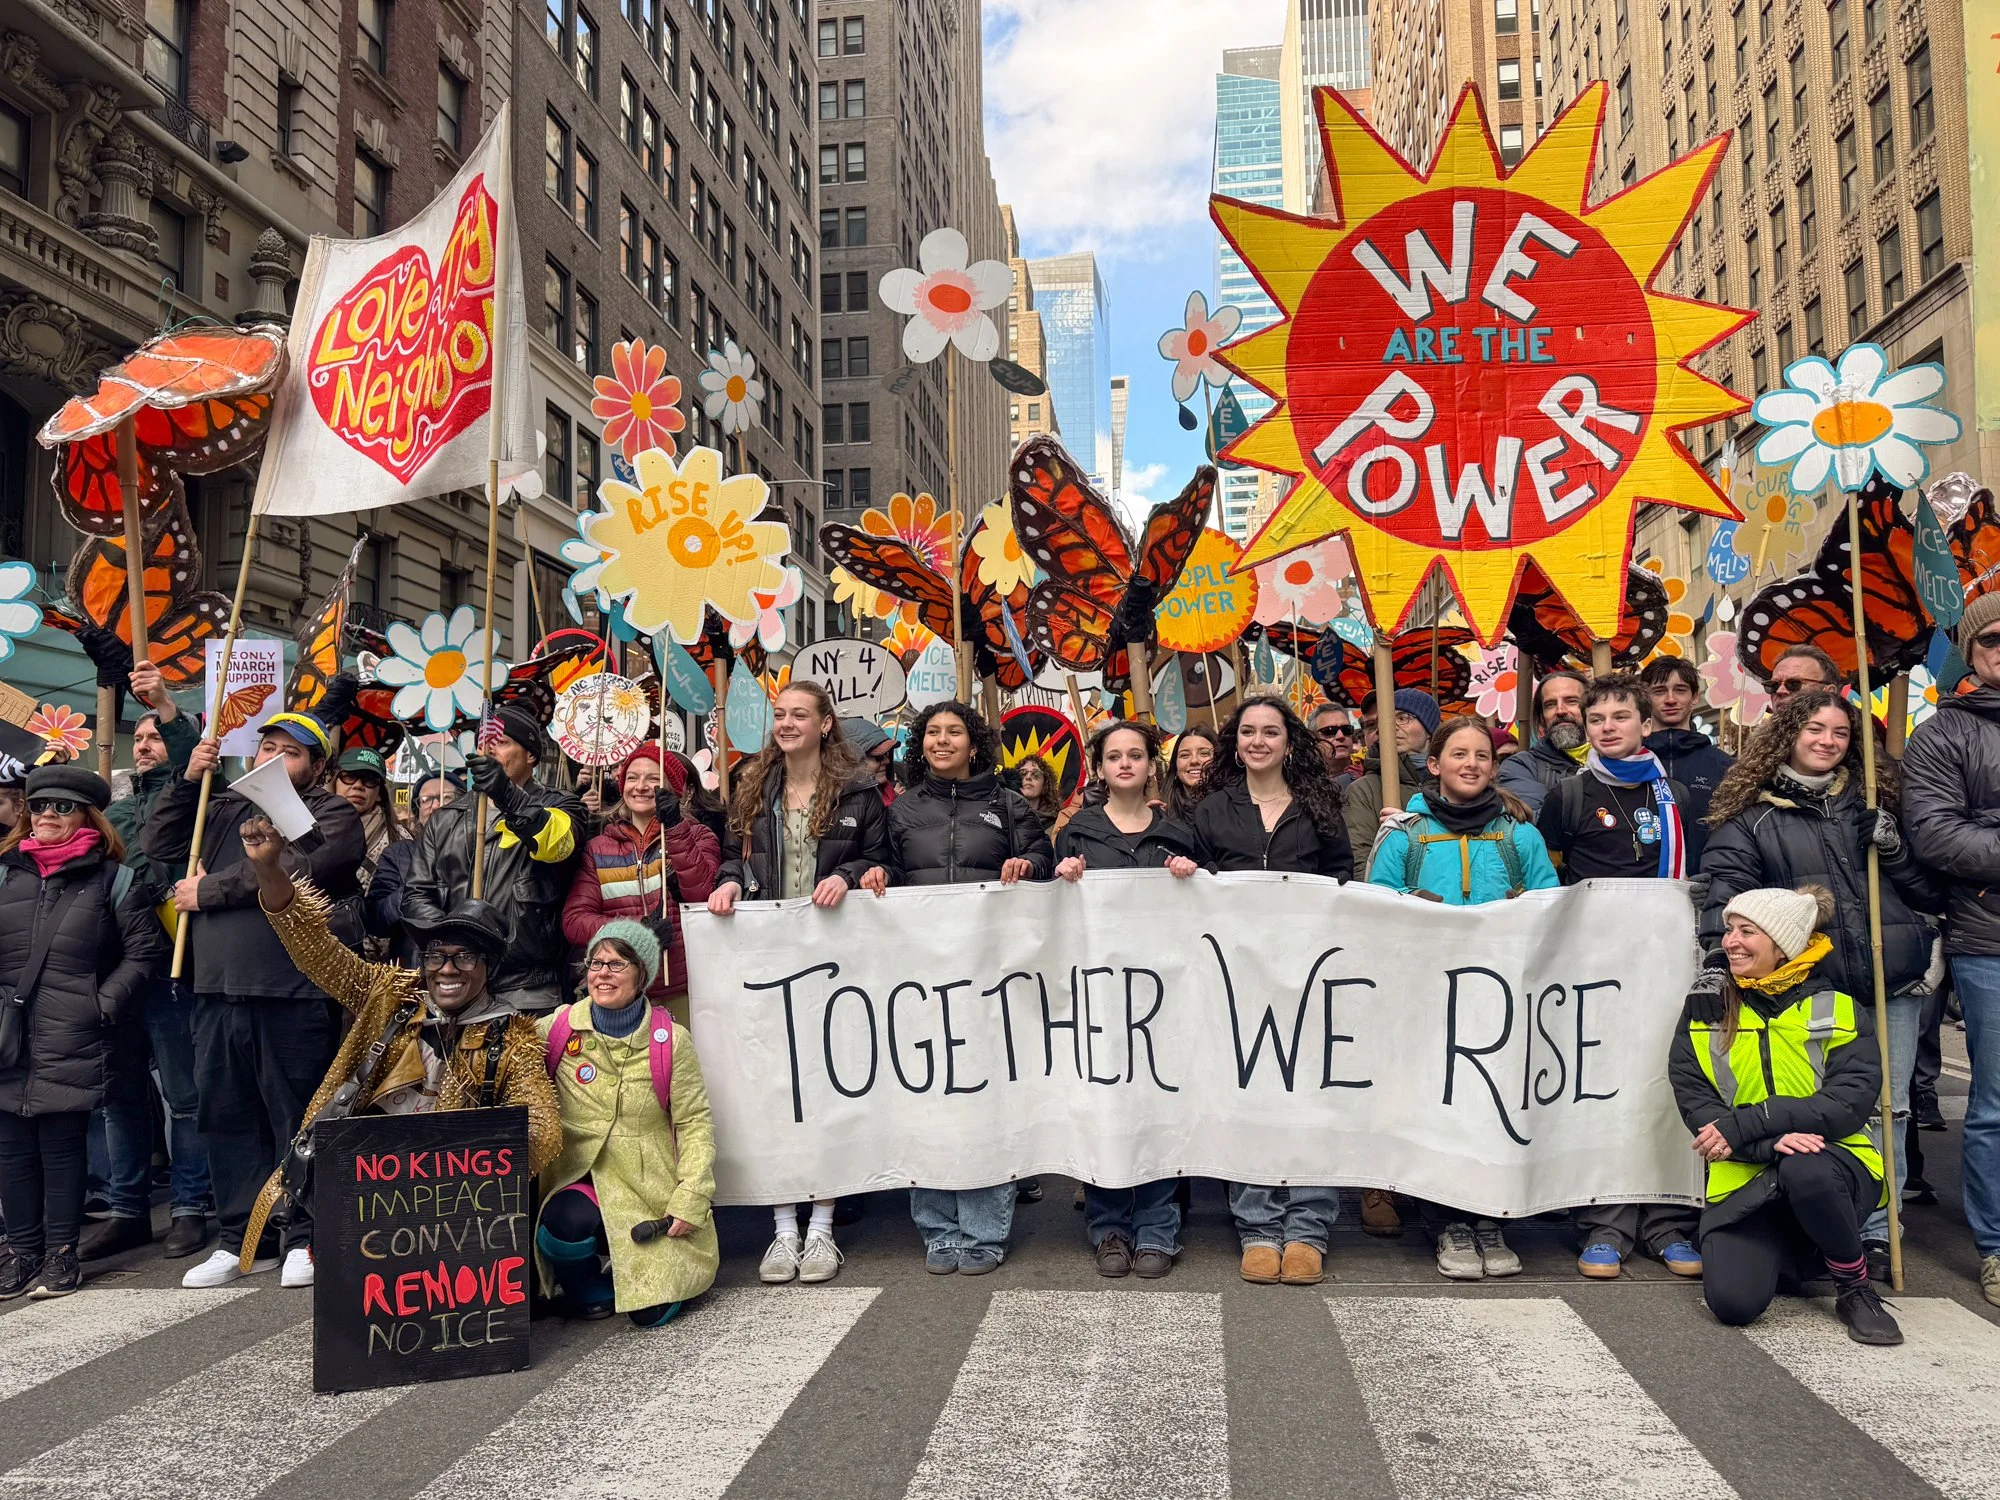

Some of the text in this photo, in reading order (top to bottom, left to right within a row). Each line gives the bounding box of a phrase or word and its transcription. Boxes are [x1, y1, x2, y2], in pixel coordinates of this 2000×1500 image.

[1352, 201, 1580, 325] WE
[1382, 327, 1555, 363] ARE THE
[1312, 370, 1643, 542] POWER
[626, 481, 758, 567] RISE UP!
[1712, 530, 1732, 549] IC
[1918, 520, 1948, 555] ICE
[1171, 561, 1236, 591] OPLE
[1707, 551, 1749, 583] MELTS
[1914, 556, 1960, 611] MELTS
[1154, 590, 1236, 620] POWER
[216, 651, 275, 660] TE ONLY
[812, 647, 876, 675] NY 4
[925, 646, 952, 666] ICE
[1474, 656, 1508, 684] RISE
[226, 673, 275, 683] UPPORT
[732, 678, 758, 697] ICE
[824, 671, 883, 705] ALL!
[908, 670, 956, 693] MELTS
[560, 734, 585, 759] KICK
[585, 753, 609, 767] HIM
[743, 933, 1622, 1146] TOGETHER WE RISE
[356, 1148, 513, 1182] NO KINGS
[358, 1175, 522, 1222] IMPEACH
[360, 1213, 527, 1260] CONVICT
[363, 1256, 526, 1317] REMOVE
[367, 1307, 515, 1359] NO ICE
